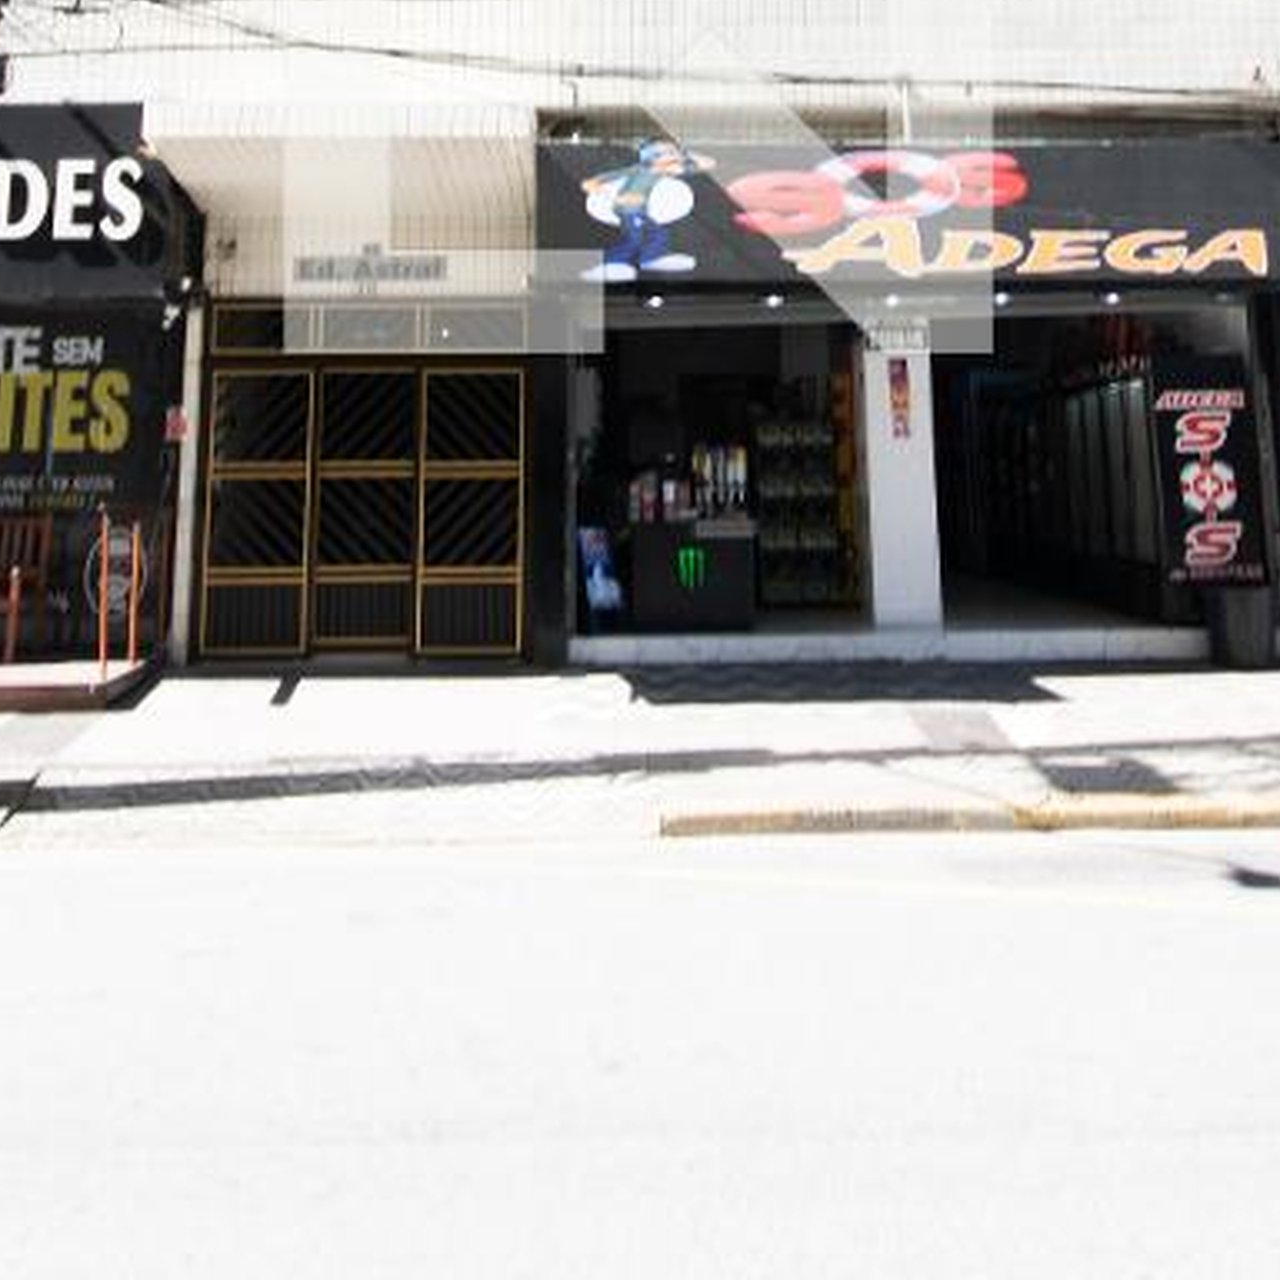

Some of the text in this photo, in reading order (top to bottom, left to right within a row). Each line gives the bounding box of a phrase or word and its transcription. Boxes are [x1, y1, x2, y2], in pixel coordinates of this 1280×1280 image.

[725, 150, 1030, 236] SOS
[782, 216, 1269, 278] ADEGA
[52, 335, 105, 365] SEM
